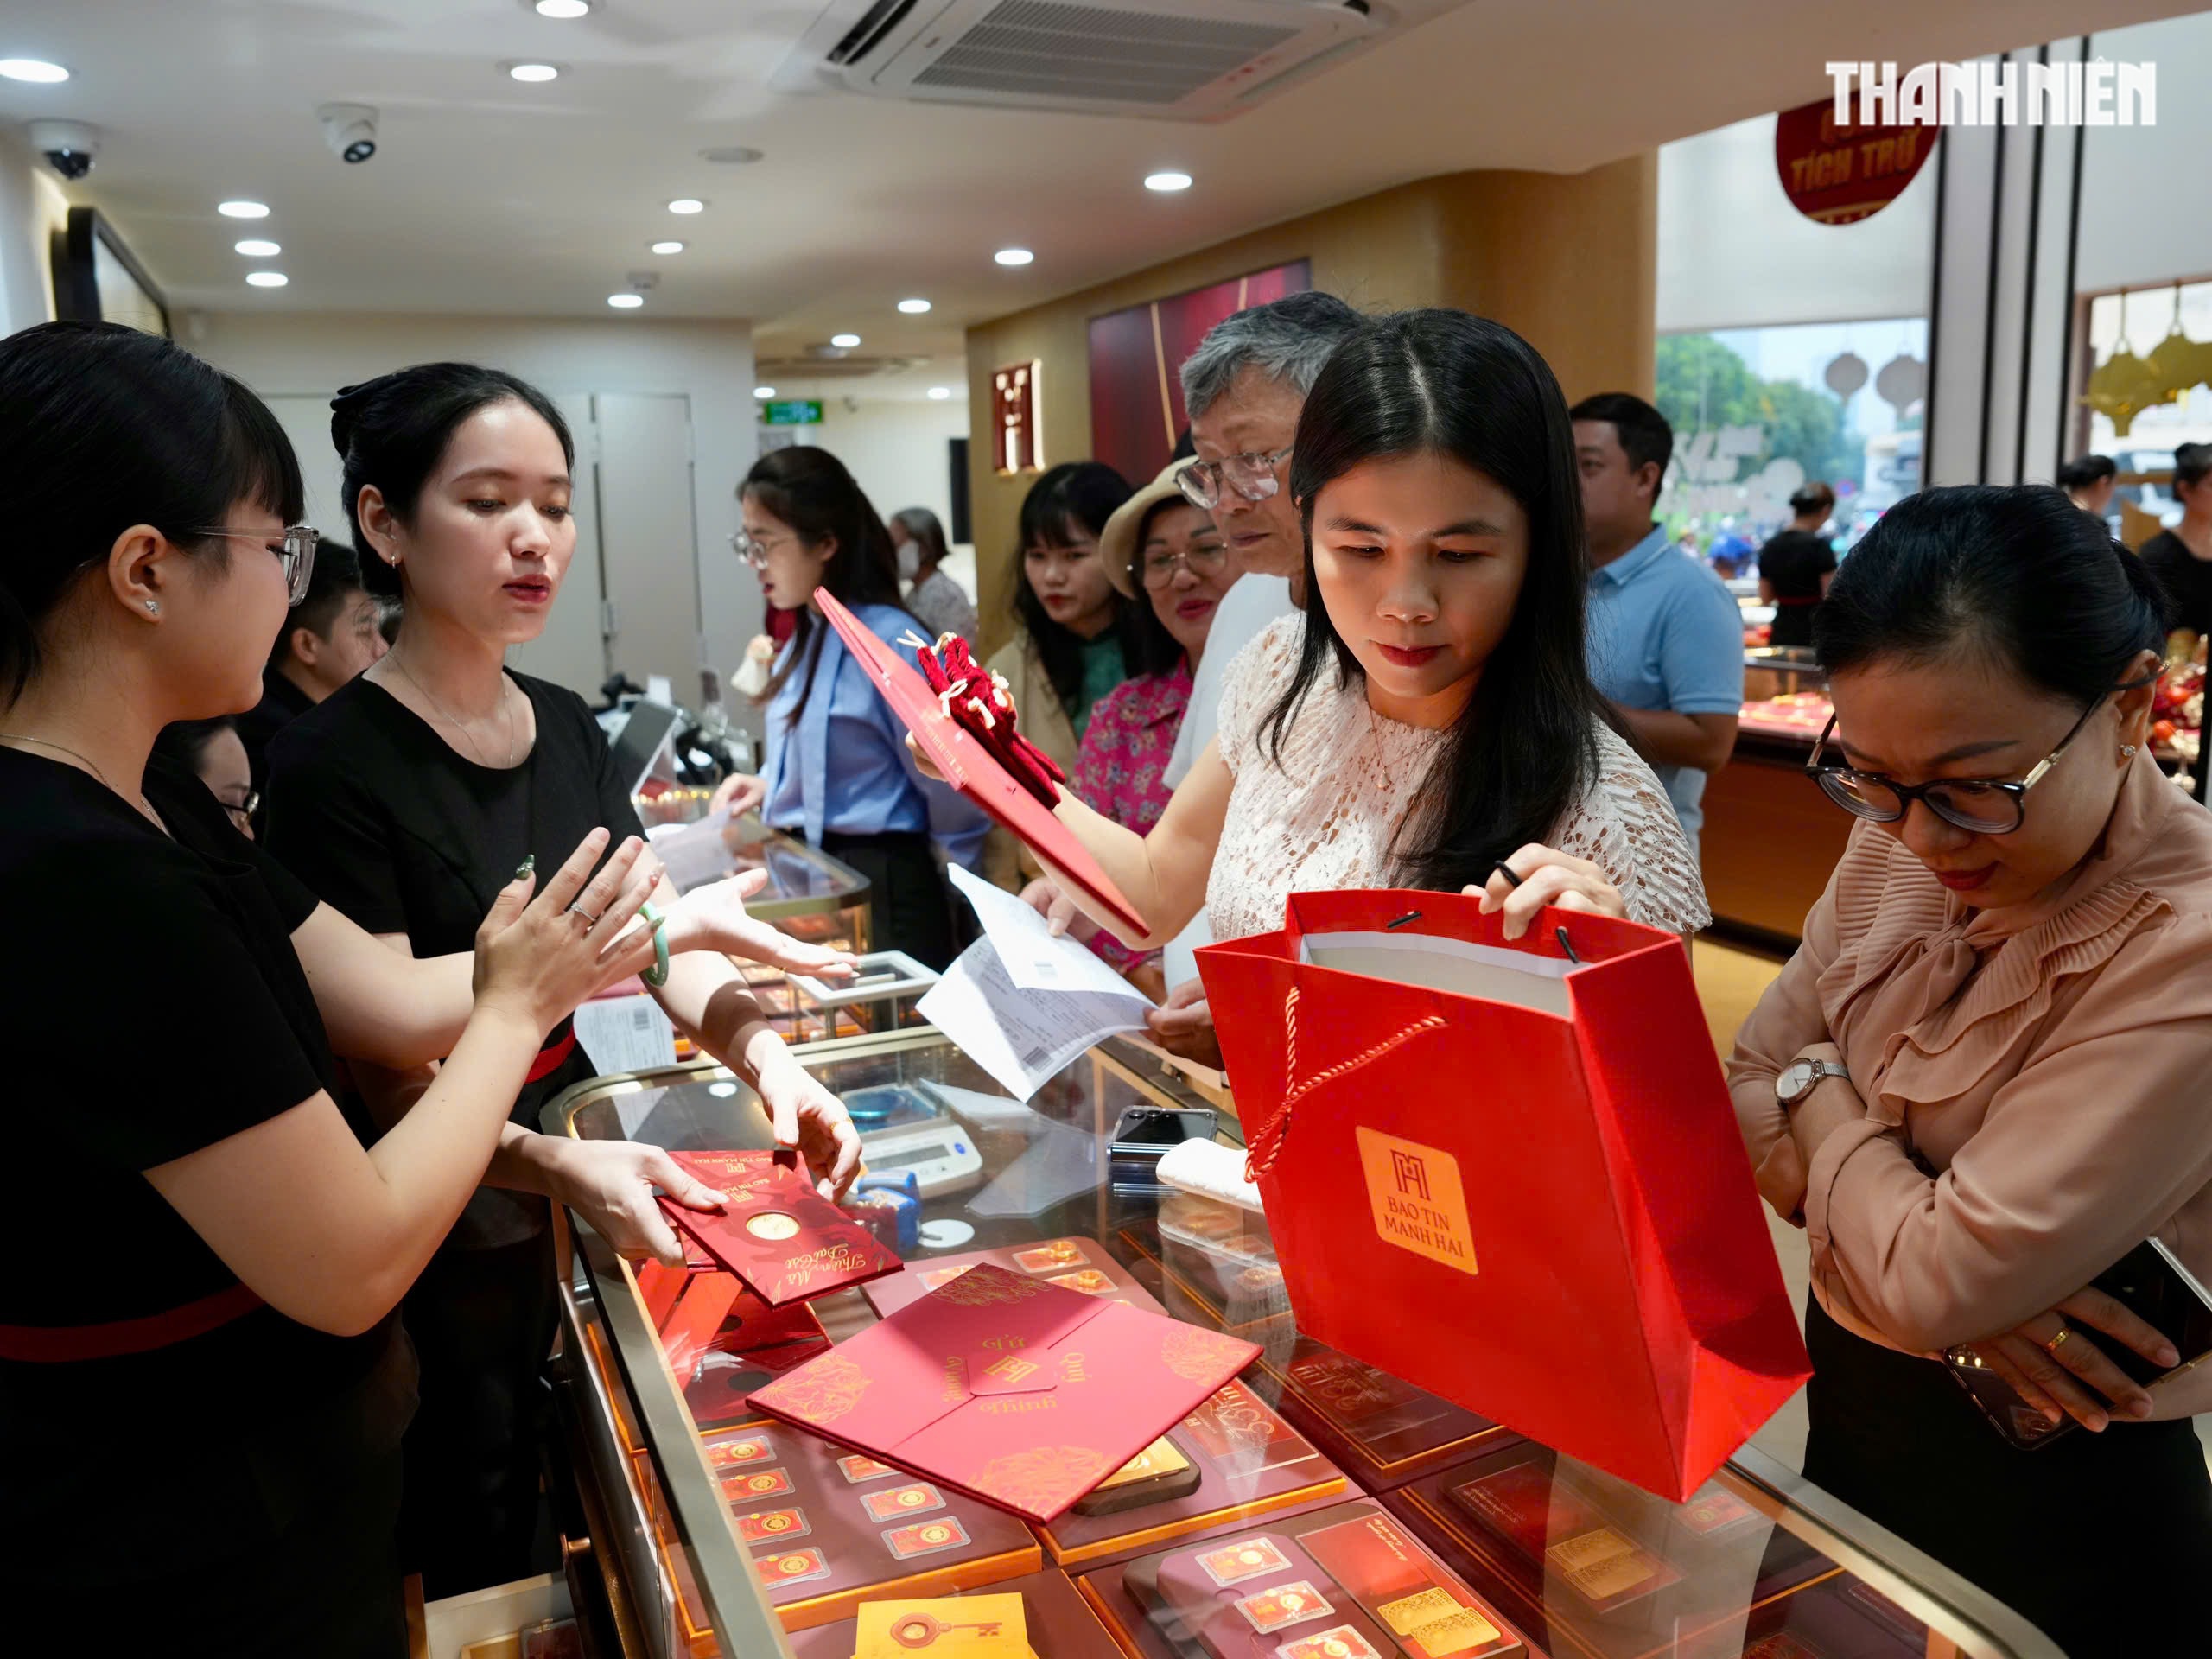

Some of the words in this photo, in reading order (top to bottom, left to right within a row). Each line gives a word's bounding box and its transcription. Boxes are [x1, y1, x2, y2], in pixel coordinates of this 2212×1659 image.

[1388, 1196, 1419, 1220] BAO
[1421, 1208, 1450, 1230] TIN
[1384, 1215, 1431, 1245] MANH
[1434, 1234, 1465, 1257] HAI
